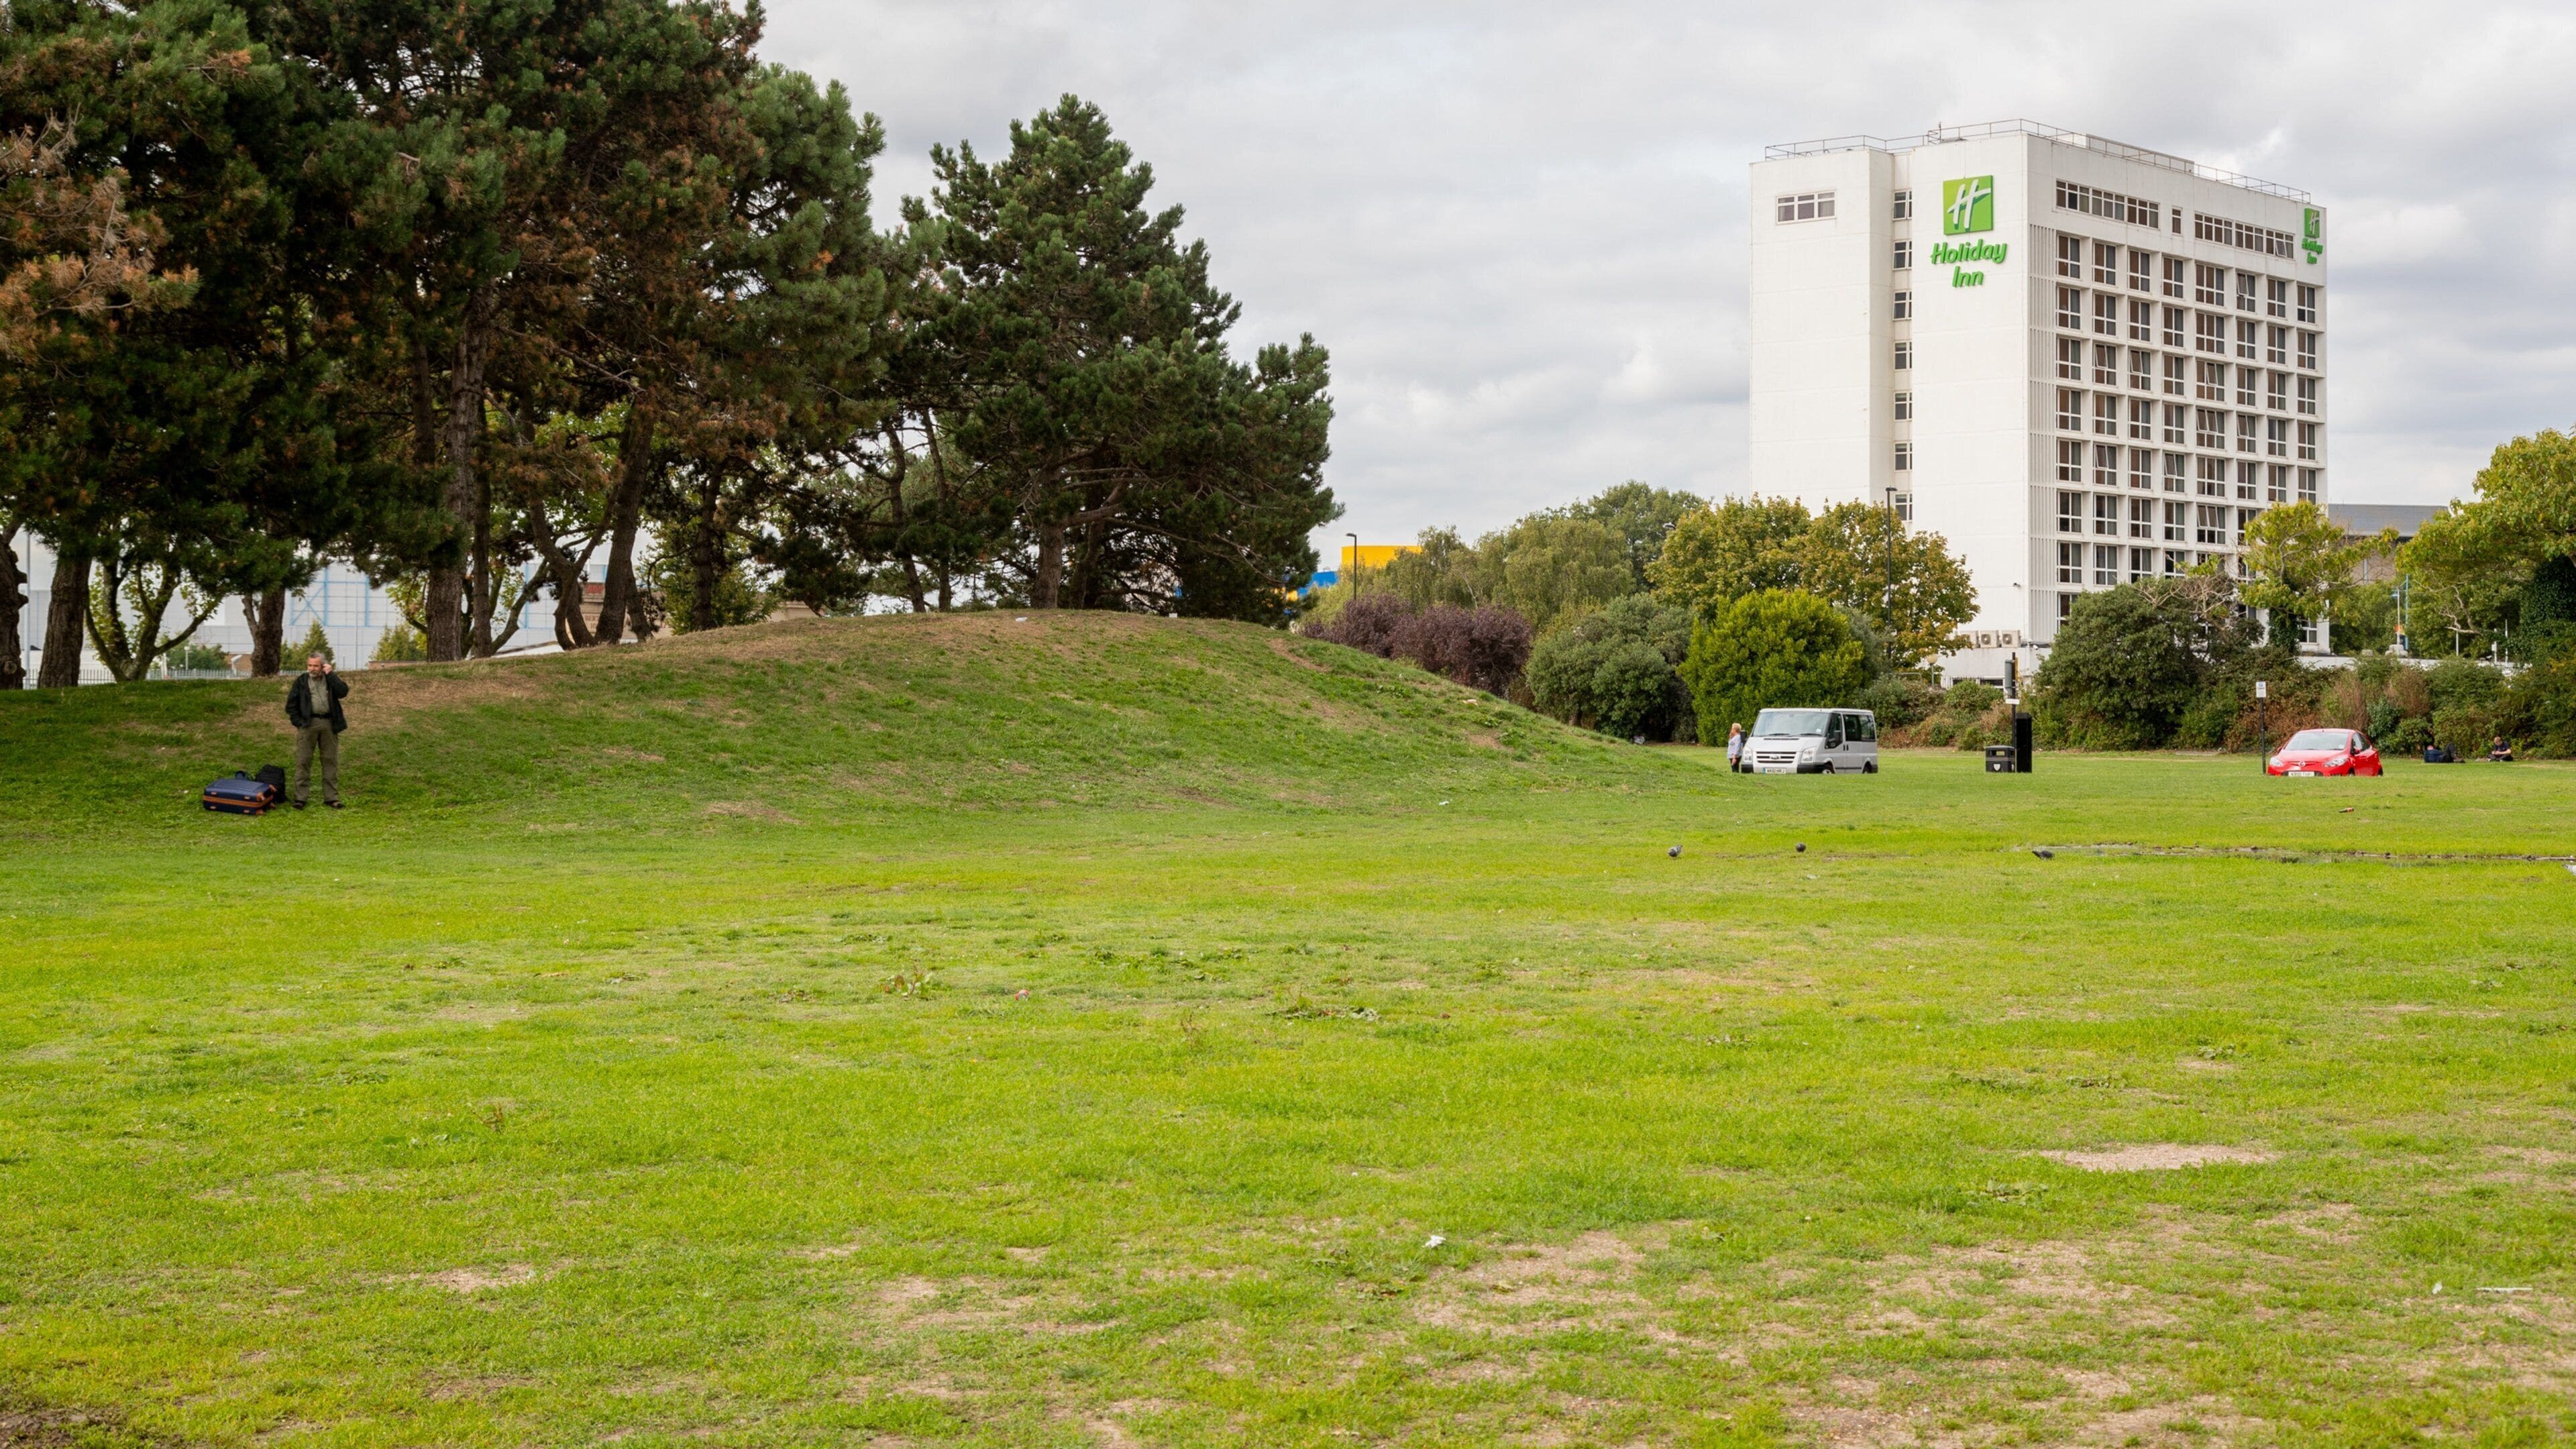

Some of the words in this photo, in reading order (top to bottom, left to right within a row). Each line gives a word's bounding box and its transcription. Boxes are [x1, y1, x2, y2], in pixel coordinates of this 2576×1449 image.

[1947, 178, 1991, 229] H
[1931, 238, 2008, 264] Holiday
[1952, 266, 1984, 288] Inn
